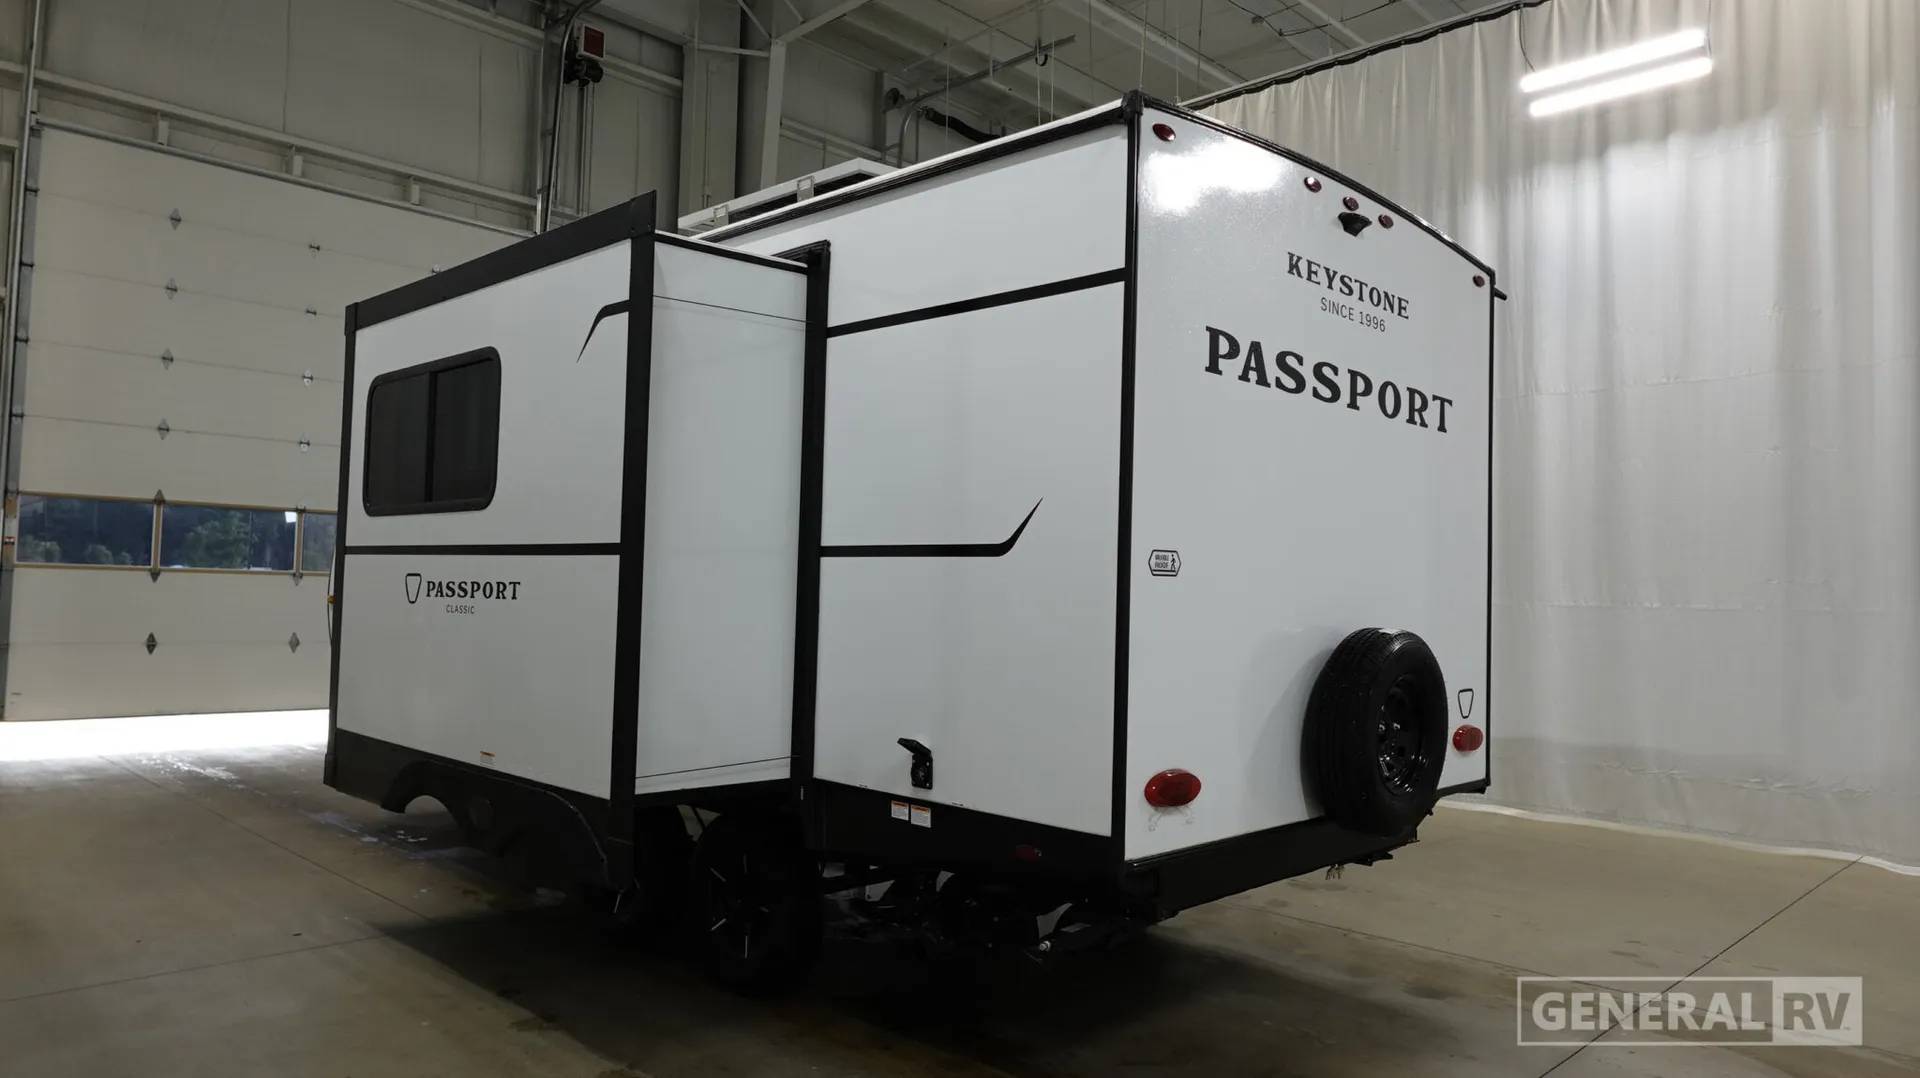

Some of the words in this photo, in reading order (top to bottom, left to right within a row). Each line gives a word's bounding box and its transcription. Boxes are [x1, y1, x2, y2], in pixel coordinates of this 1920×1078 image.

[1287, 251, 1410, 320] KEYSTONE
[1320, 297, 1354, 321] SINCE
[1359, 311, 1386, 333] 1996
[1205, 326, 1453, 434] PASSPORT
[426, 581, 521, 600] PASSPORT
[446, 604, 475, 614] CLASSIC
